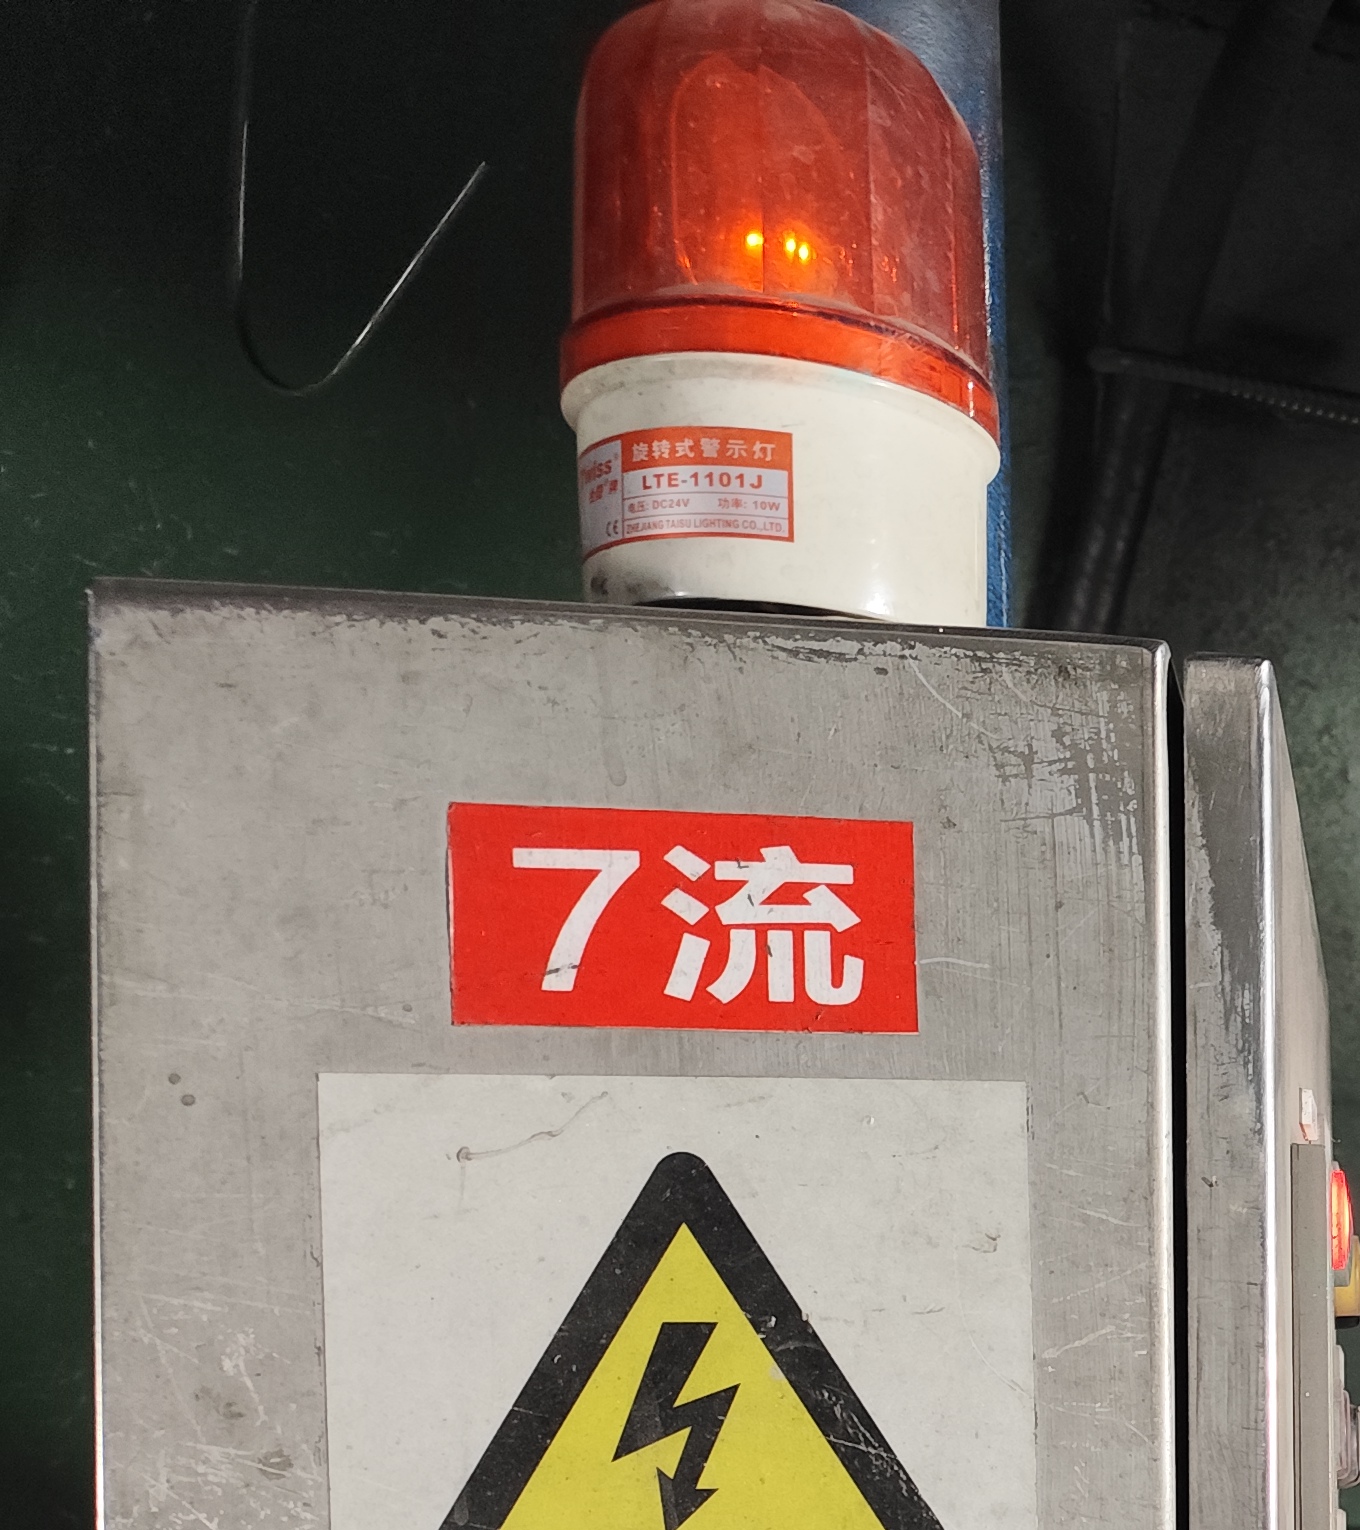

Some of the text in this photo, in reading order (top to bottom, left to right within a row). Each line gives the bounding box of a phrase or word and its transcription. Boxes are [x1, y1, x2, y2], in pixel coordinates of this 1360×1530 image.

[632, 437, 776, 462] 旋转式警示灯
[641, 471, 763, 491] LTE-1101J
[652, 498, 690, 510] DC24V
[752, 501, 781, 511] 10W
[626, 519, 664, 534] ZHEJIANG
[666, 518, 691, 530] TAISU
[693, 519, 740, 529] LIGHTING
